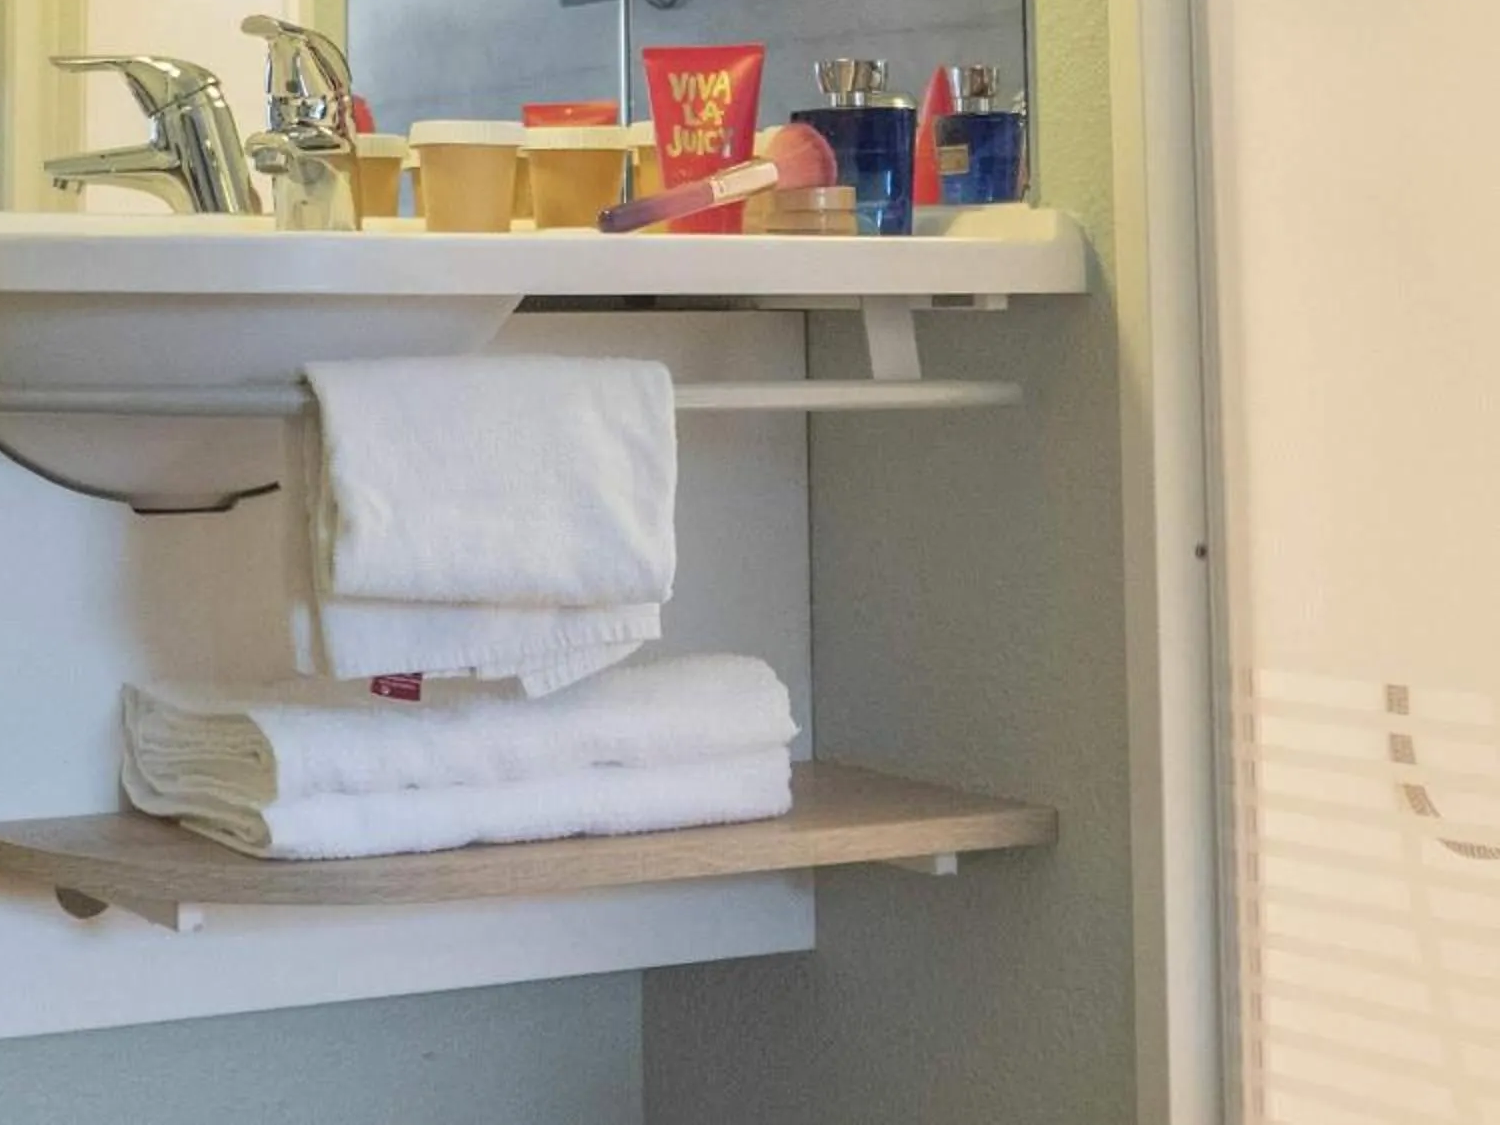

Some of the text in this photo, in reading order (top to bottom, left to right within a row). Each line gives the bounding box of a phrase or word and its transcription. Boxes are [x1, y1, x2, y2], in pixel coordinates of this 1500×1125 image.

[668, 70, 732, 105] VIVA
[682, 100, 725, 126] LA
[665, 125, 736, 159] JUICY
